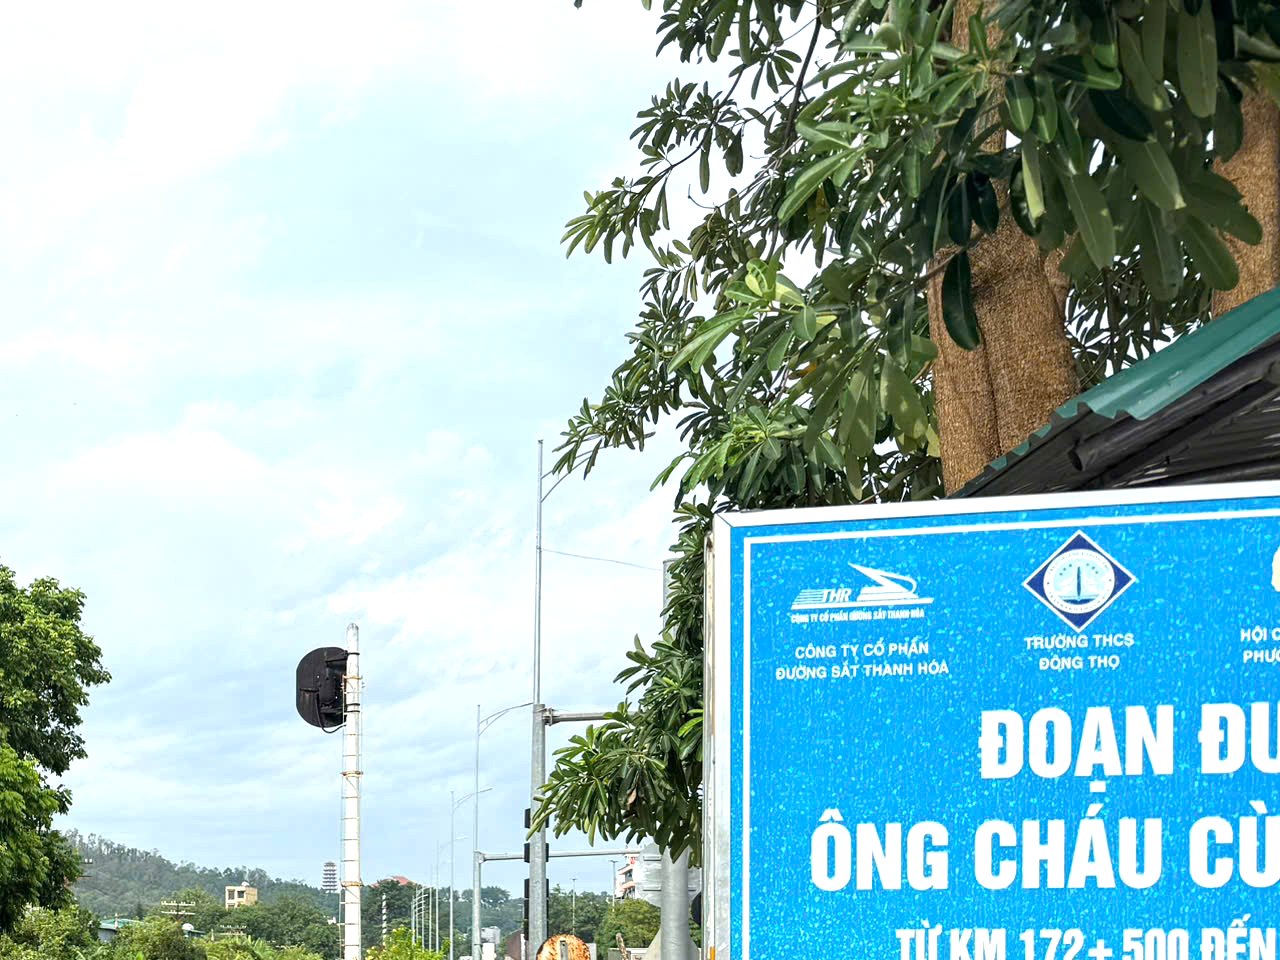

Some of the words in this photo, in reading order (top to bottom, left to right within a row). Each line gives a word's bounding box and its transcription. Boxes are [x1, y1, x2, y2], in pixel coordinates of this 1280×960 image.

[822, 588, 852, 602] THR
[1024, 633, 1088, 649] TRƯỜNG
[1092, 633, 1134, 648] THCS
[1240, 625, 1268, 643] HỘI
[795, 643, 836, 659] CÔNG
[841, 644, 859, 657] TY
[863, 637, 885, 656] CỔ
[888, 635, 929, 656] PHẦN
[776, 664, 827, 680] ĐƯỜNG
[831, 660, 859, 677] SẮT
[863, 663, 913, 677] THANH
[918, 659, 949, 675] HÓA
[1039, 654, 1083, 670] ĐÔNG
[1088, 654, 1120, 670] THỌ
[978, 704, 1174, 793] ĐOẠN
[810, 808, 950, 892] ÔNG
[974, 804, 1163, 890] CHÁU
